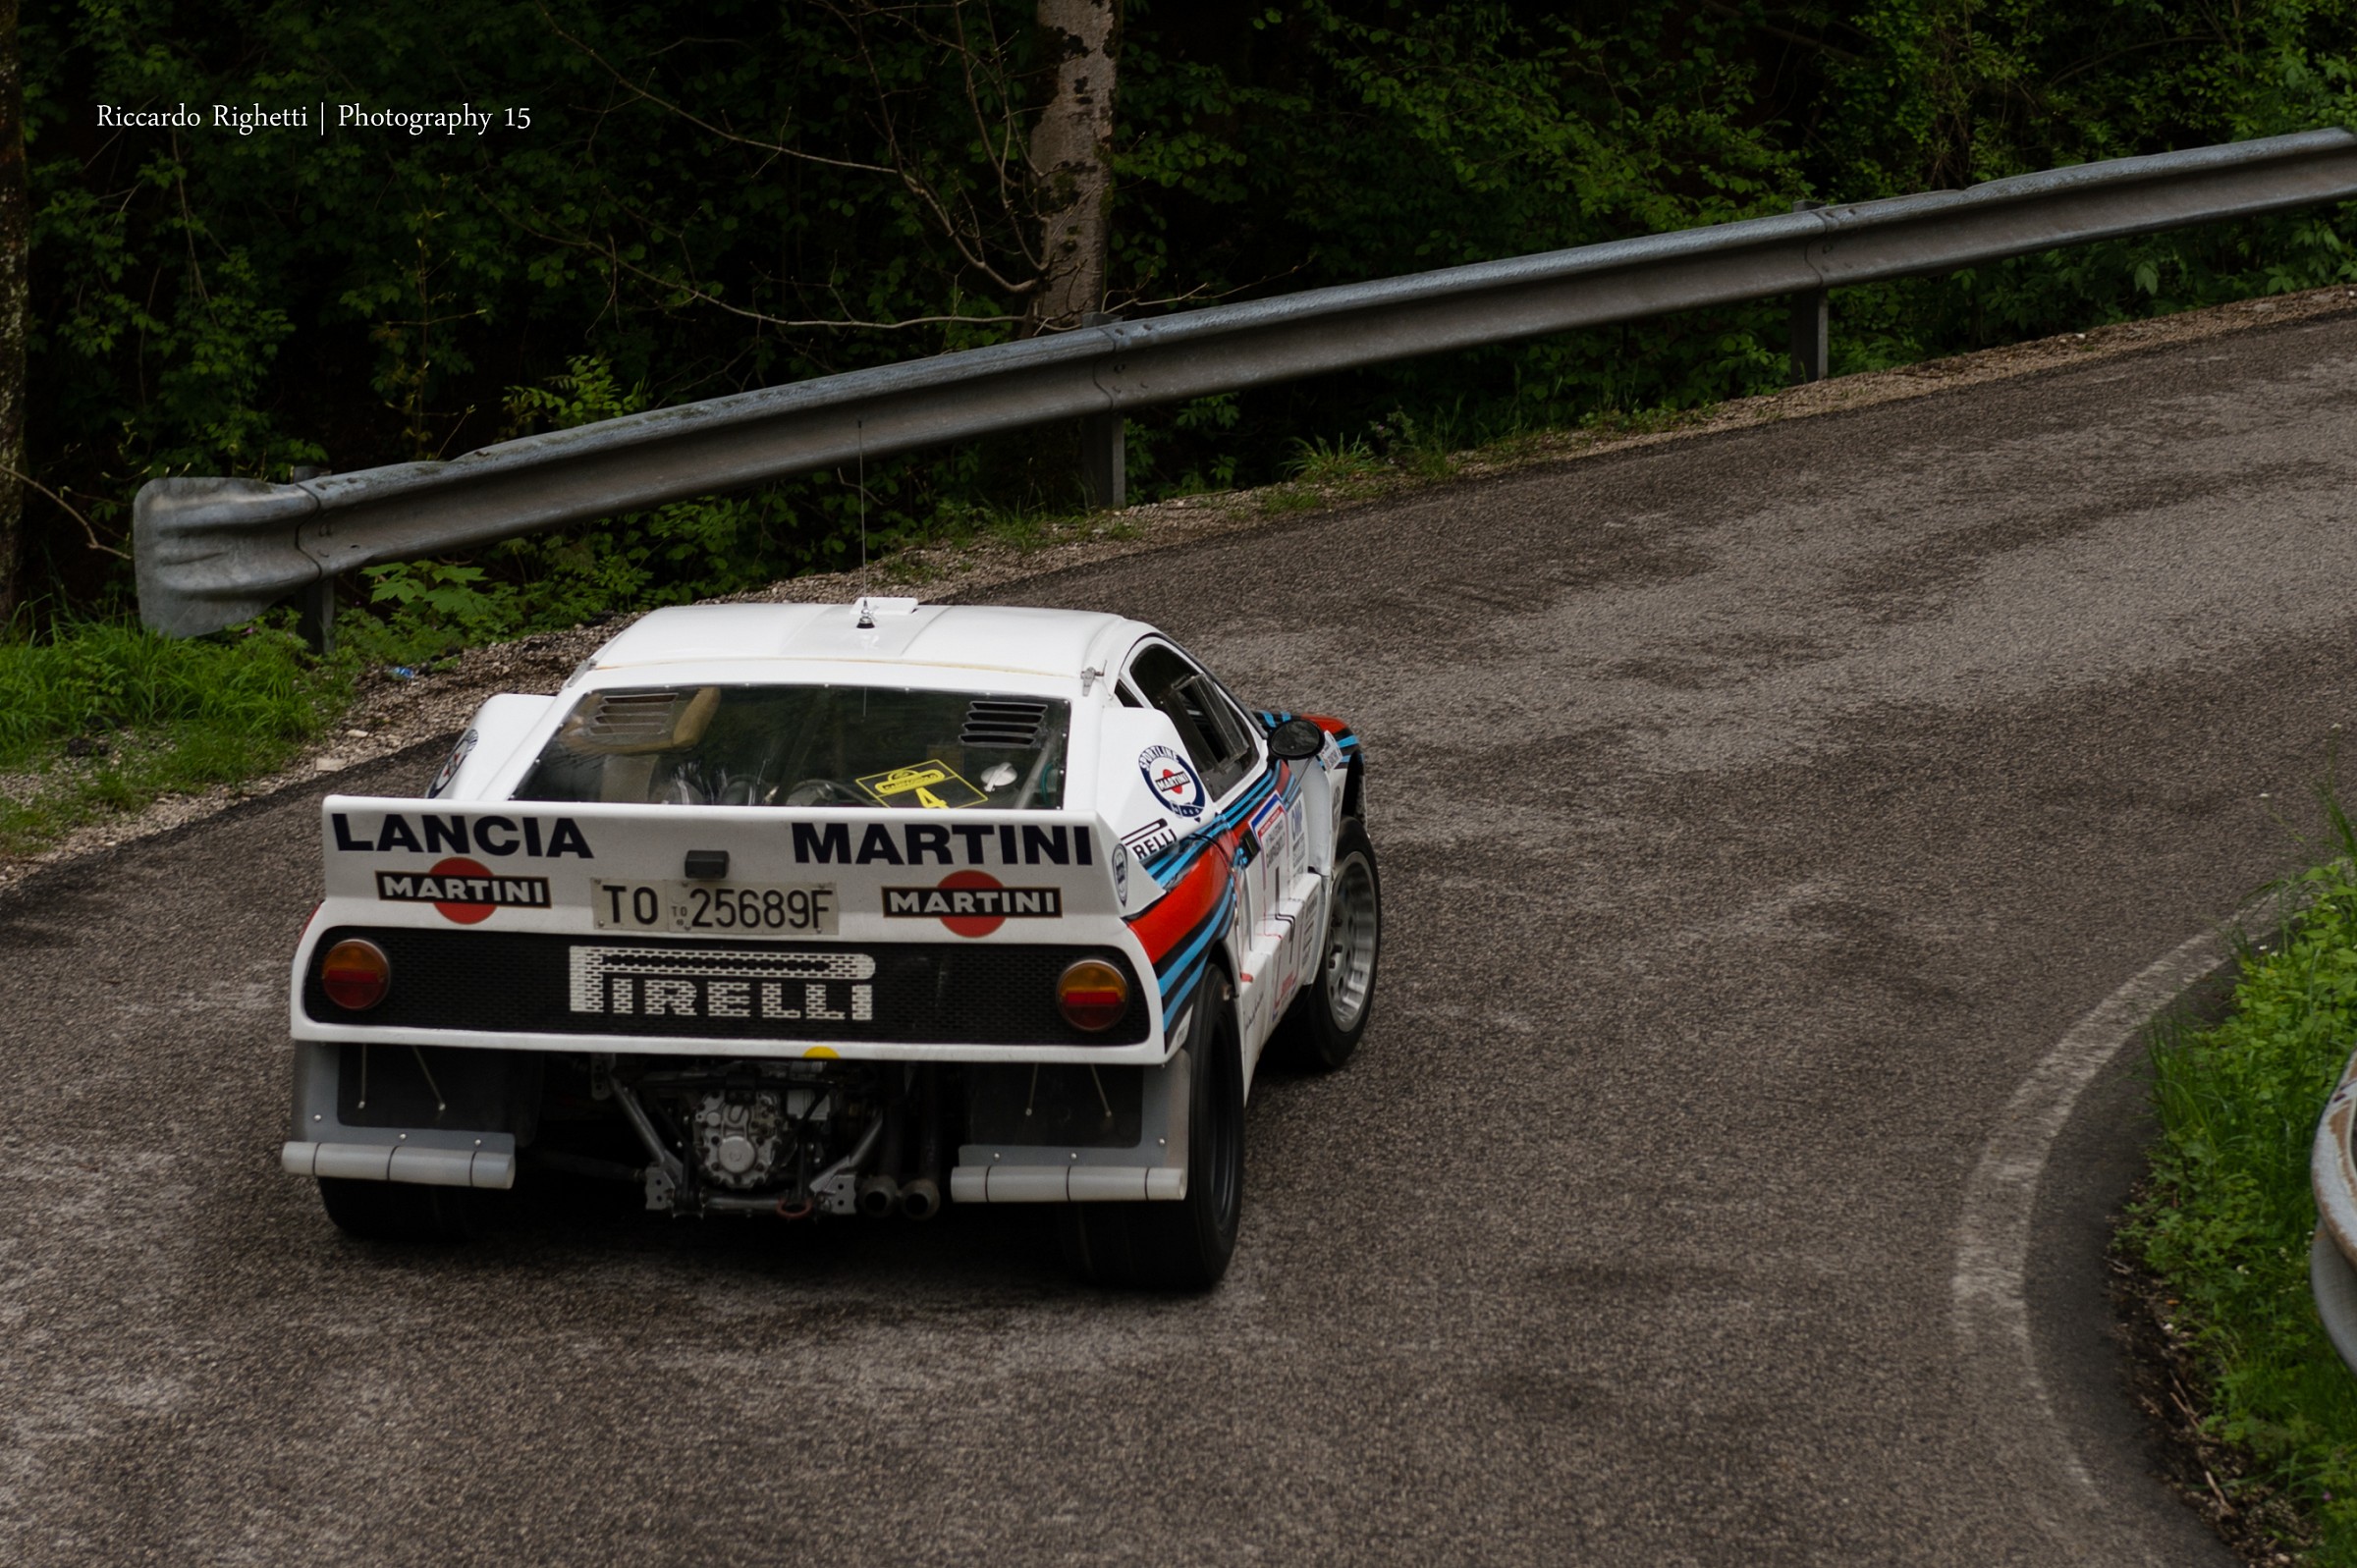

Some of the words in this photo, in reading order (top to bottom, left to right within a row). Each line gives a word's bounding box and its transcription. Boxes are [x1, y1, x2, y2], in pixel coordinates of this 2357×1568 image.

[331, 813, 594, 859] LANCIA
[791, 822, 1093, 866] MARTINI
[383, 876, 545, 904] MARTINI
[602, 885, 659, 925] TO
[689, 888, 833, 929] 25689F
[889, 891, 1056, 914] MARTINI
[570, 946, 876, 1020] PIRELLI
